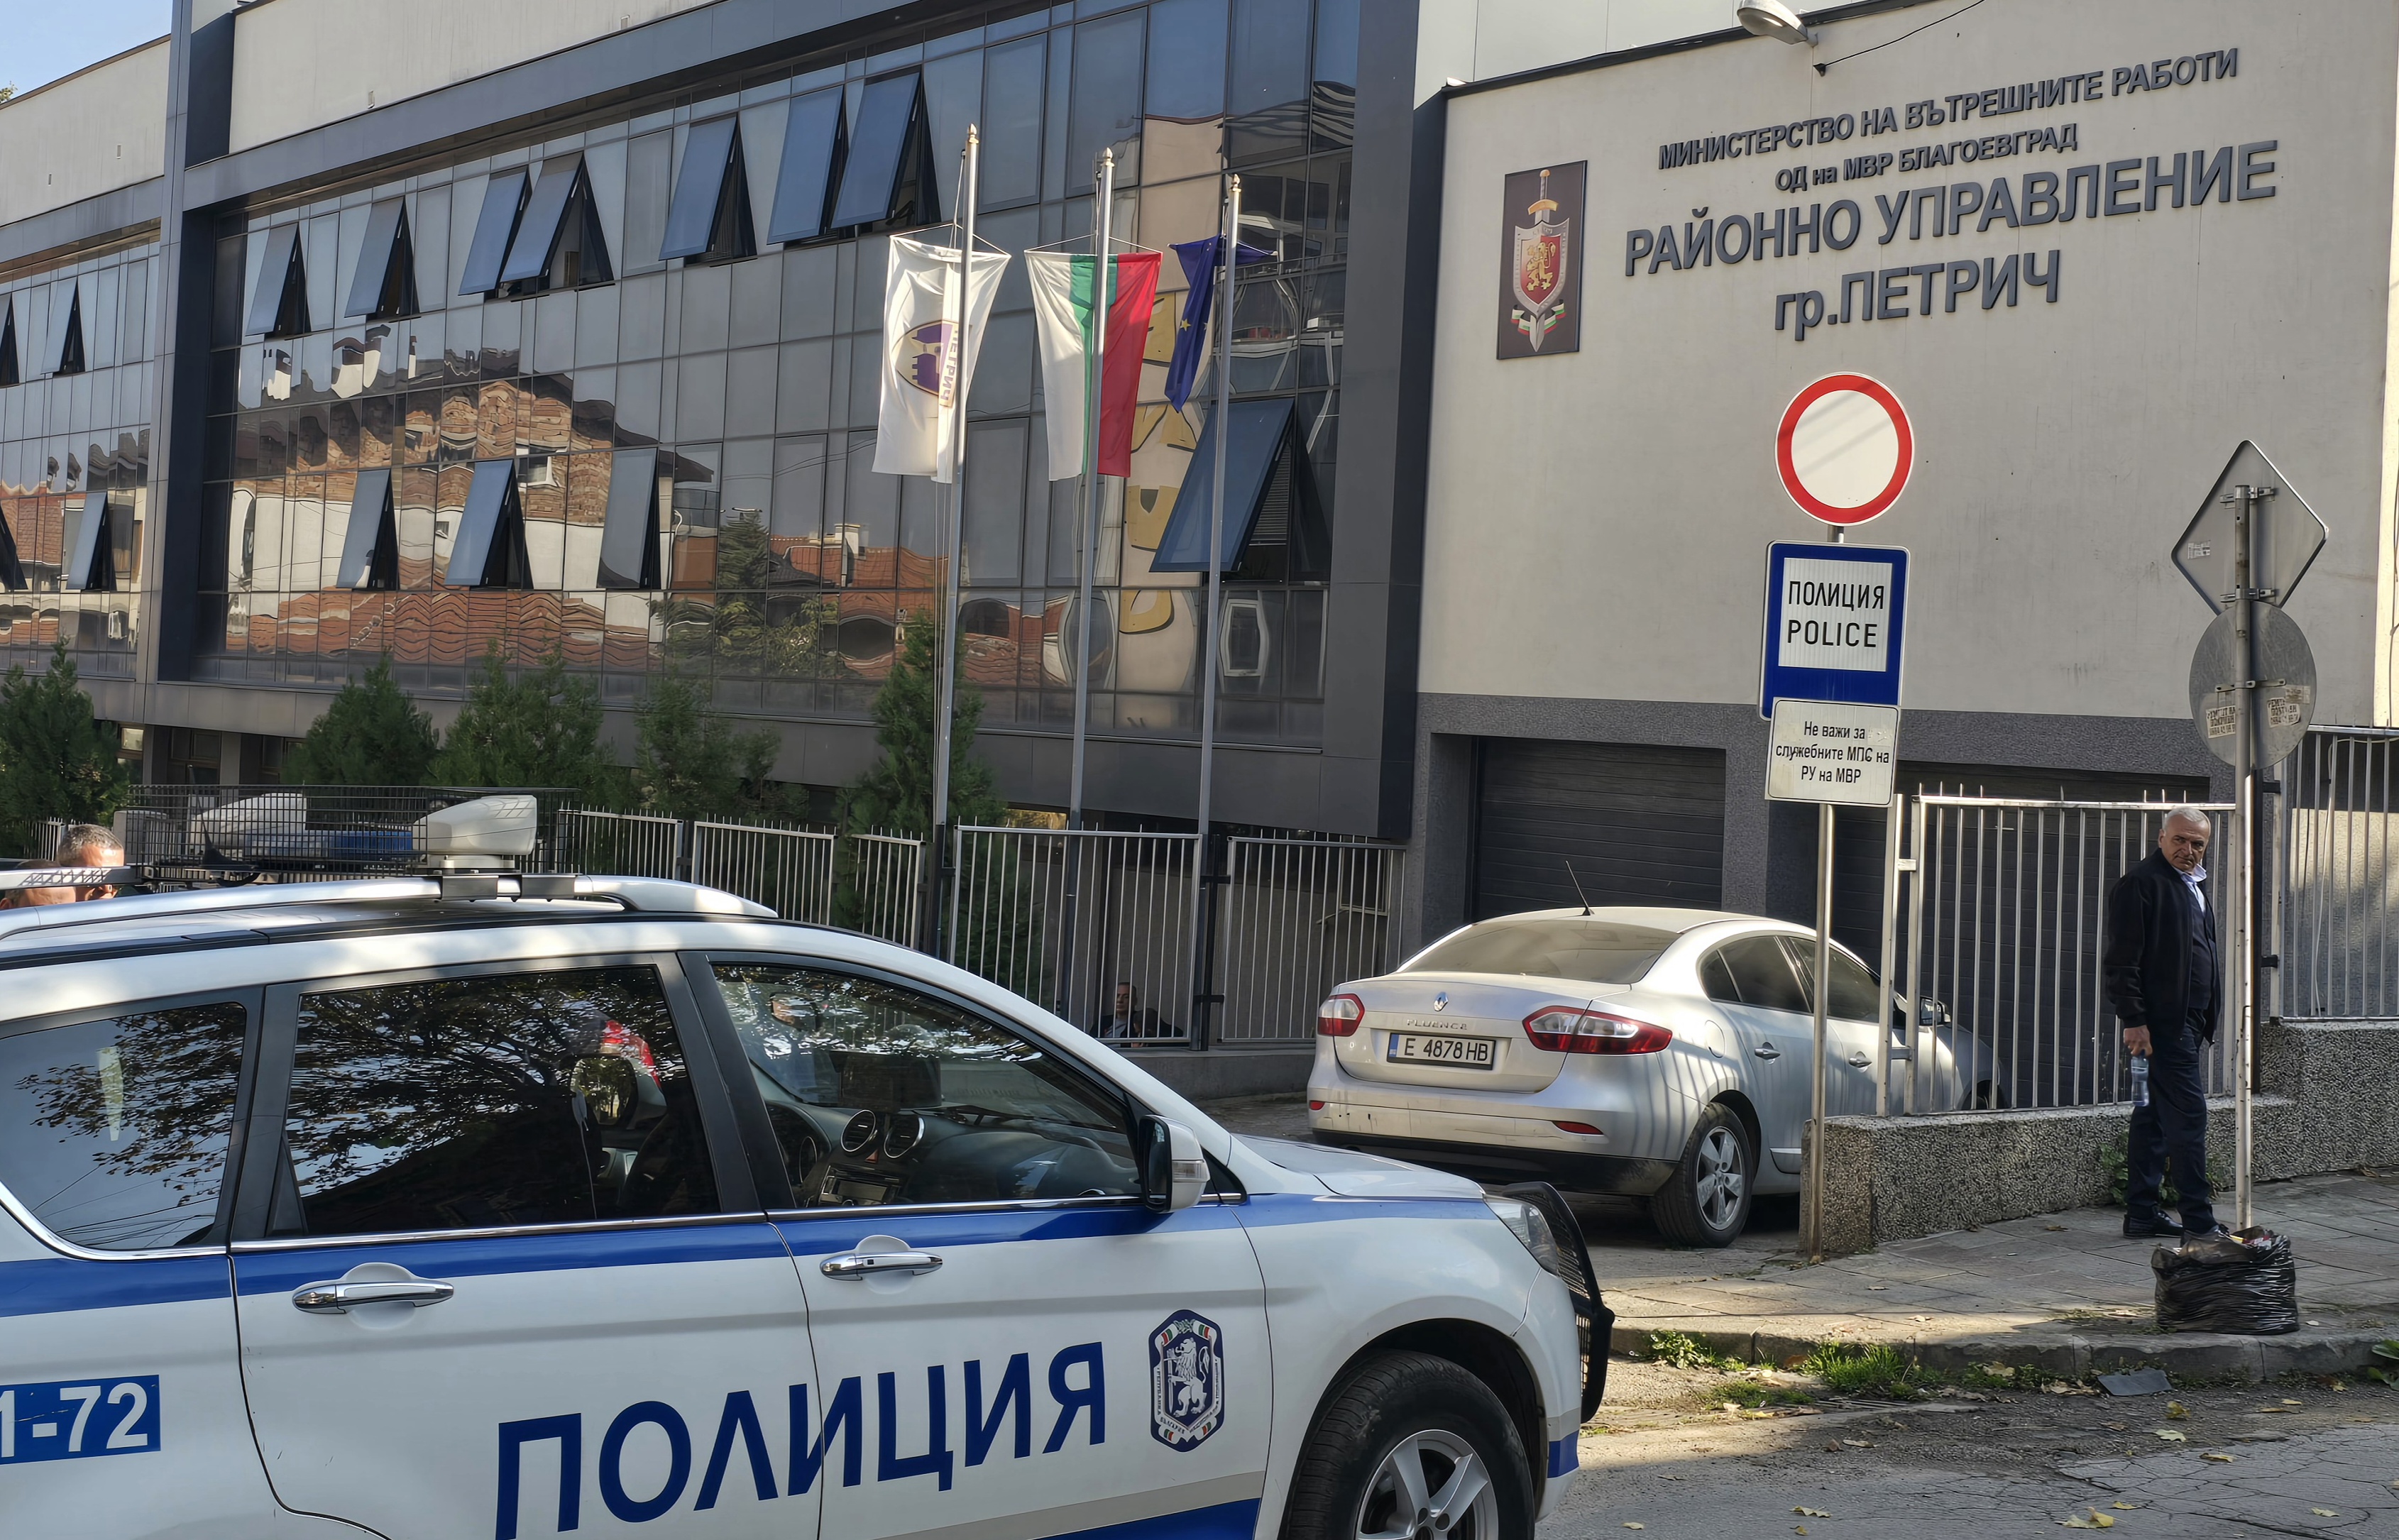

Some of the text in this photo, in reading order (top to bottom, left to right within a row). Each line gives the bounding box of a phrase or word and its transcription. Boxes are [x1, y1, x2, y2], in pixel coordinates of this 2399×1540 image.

[1659, 48, 2238, 170] МИНИСТЕРСТВО НА ВЪТРЕШНИТЕ РАБОТИ
[1774, 123, 2077, 193] ОД на МВР БЛАГОЕВГРАД
[1625, 199, 1861, 276] РАЙОННО
[1874, 140, 2278, 245] УПРАВЛЕНИЕ
[1774, 249, 2060, 341] гр.ПЕТРИЧ
[940, 330, 958, 400] ЕТРИЧ
[1788, 581, 1884, 611] ПОЛИЦИЯ
[1787, 620, 1877, 647] POLICE
[1776, 743, 1889, 763] служебните МПС на
[1804, 721, 1865, 739] Не важи за
[1801, 765, 1861, 783] РУ на МВР
[1423, 1039, 1463, 1059] 4878
[0, 1382, 148, 1458] 1-72
[495, 1341, 1105, 1540] ПОЛИЦИЯ
